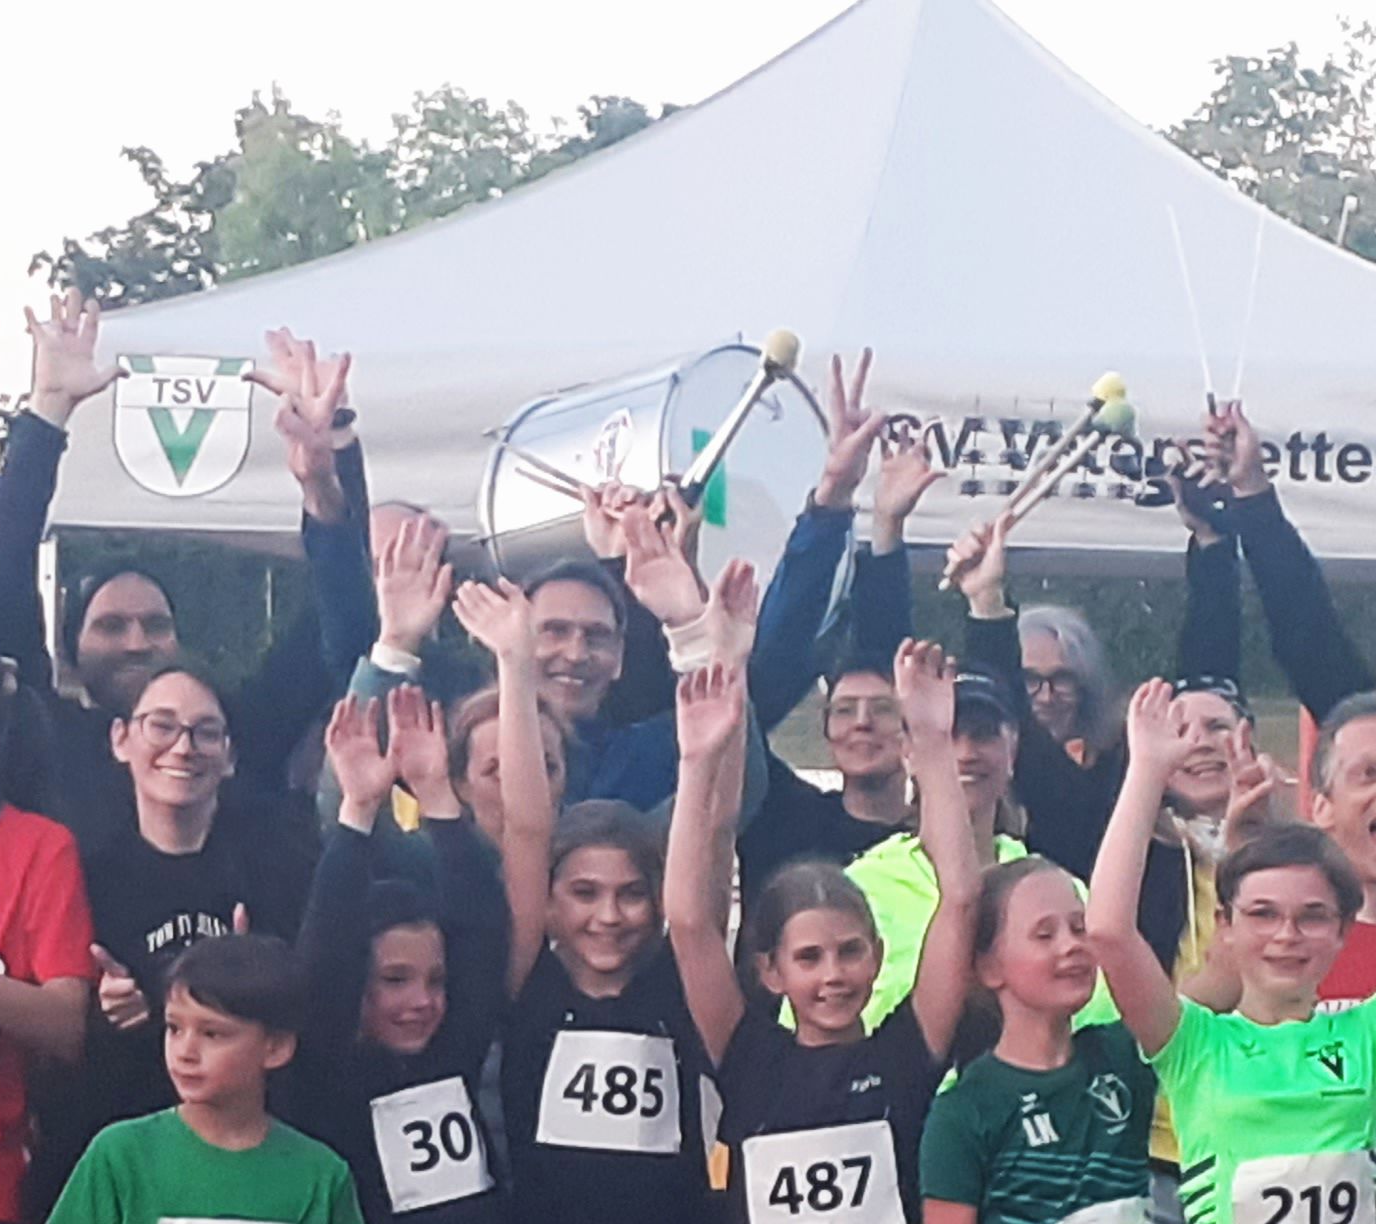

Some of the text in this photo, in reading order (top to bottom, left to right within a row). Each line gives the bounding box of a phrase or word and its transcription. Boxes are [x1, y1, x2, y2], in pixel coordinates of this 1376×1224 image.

[152, 378, 216, 404] TSV
[562, 1063, 664, 1118] 485
[402, 1111, 473, 1171] 30
[769, 1155, 872, 1215] 487
